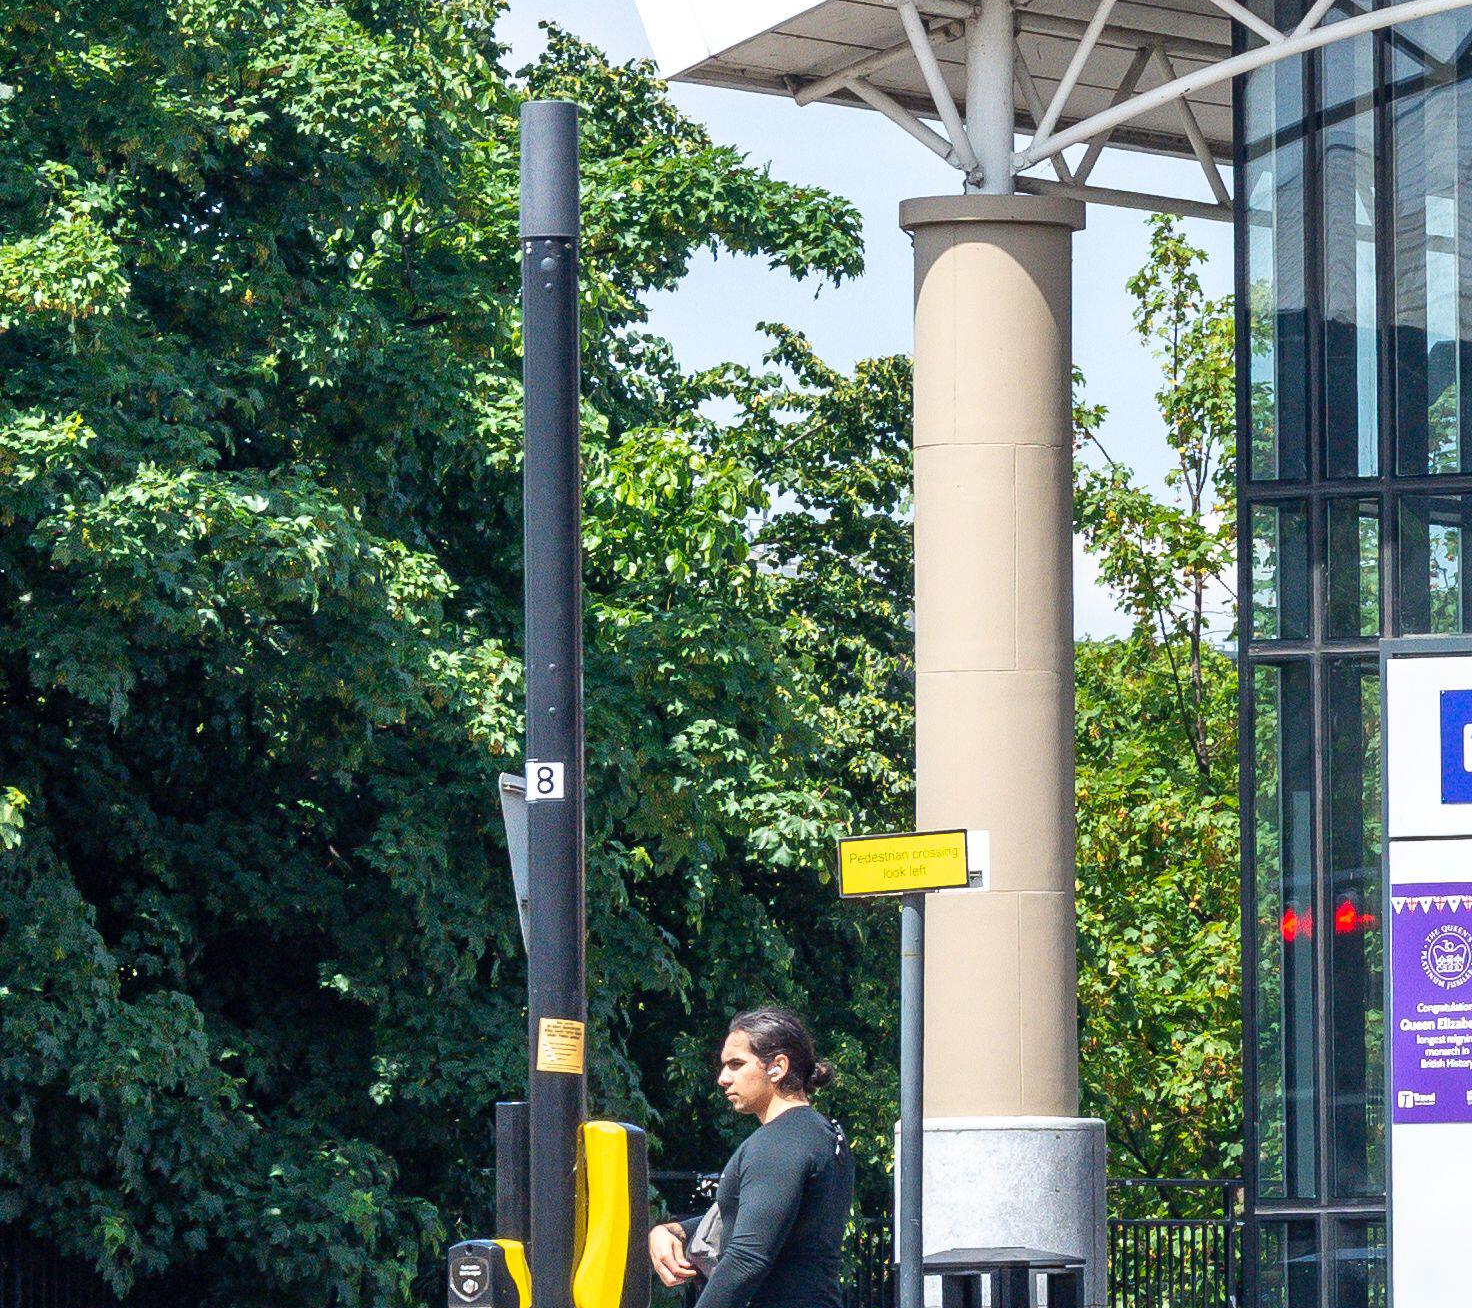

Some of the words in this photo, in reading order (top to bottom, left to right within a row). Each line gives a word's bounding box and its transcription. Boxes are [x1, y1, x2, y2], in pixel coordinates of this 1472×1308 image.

[537, 765, 555, 795] 8
[850, 850, 909, 864] Pedestrian
[912, 846, 958, 860] crossing
[882, 867, 905, 878] look
[909, 864, 926, 876] left
[1400, 1019, 1435, 1031] Queen
[1417, 1034, 1446, 1046] longest
[1425, 1046, 1460, 1056] monarch
[1420, 1058, 1445, 1068] British
